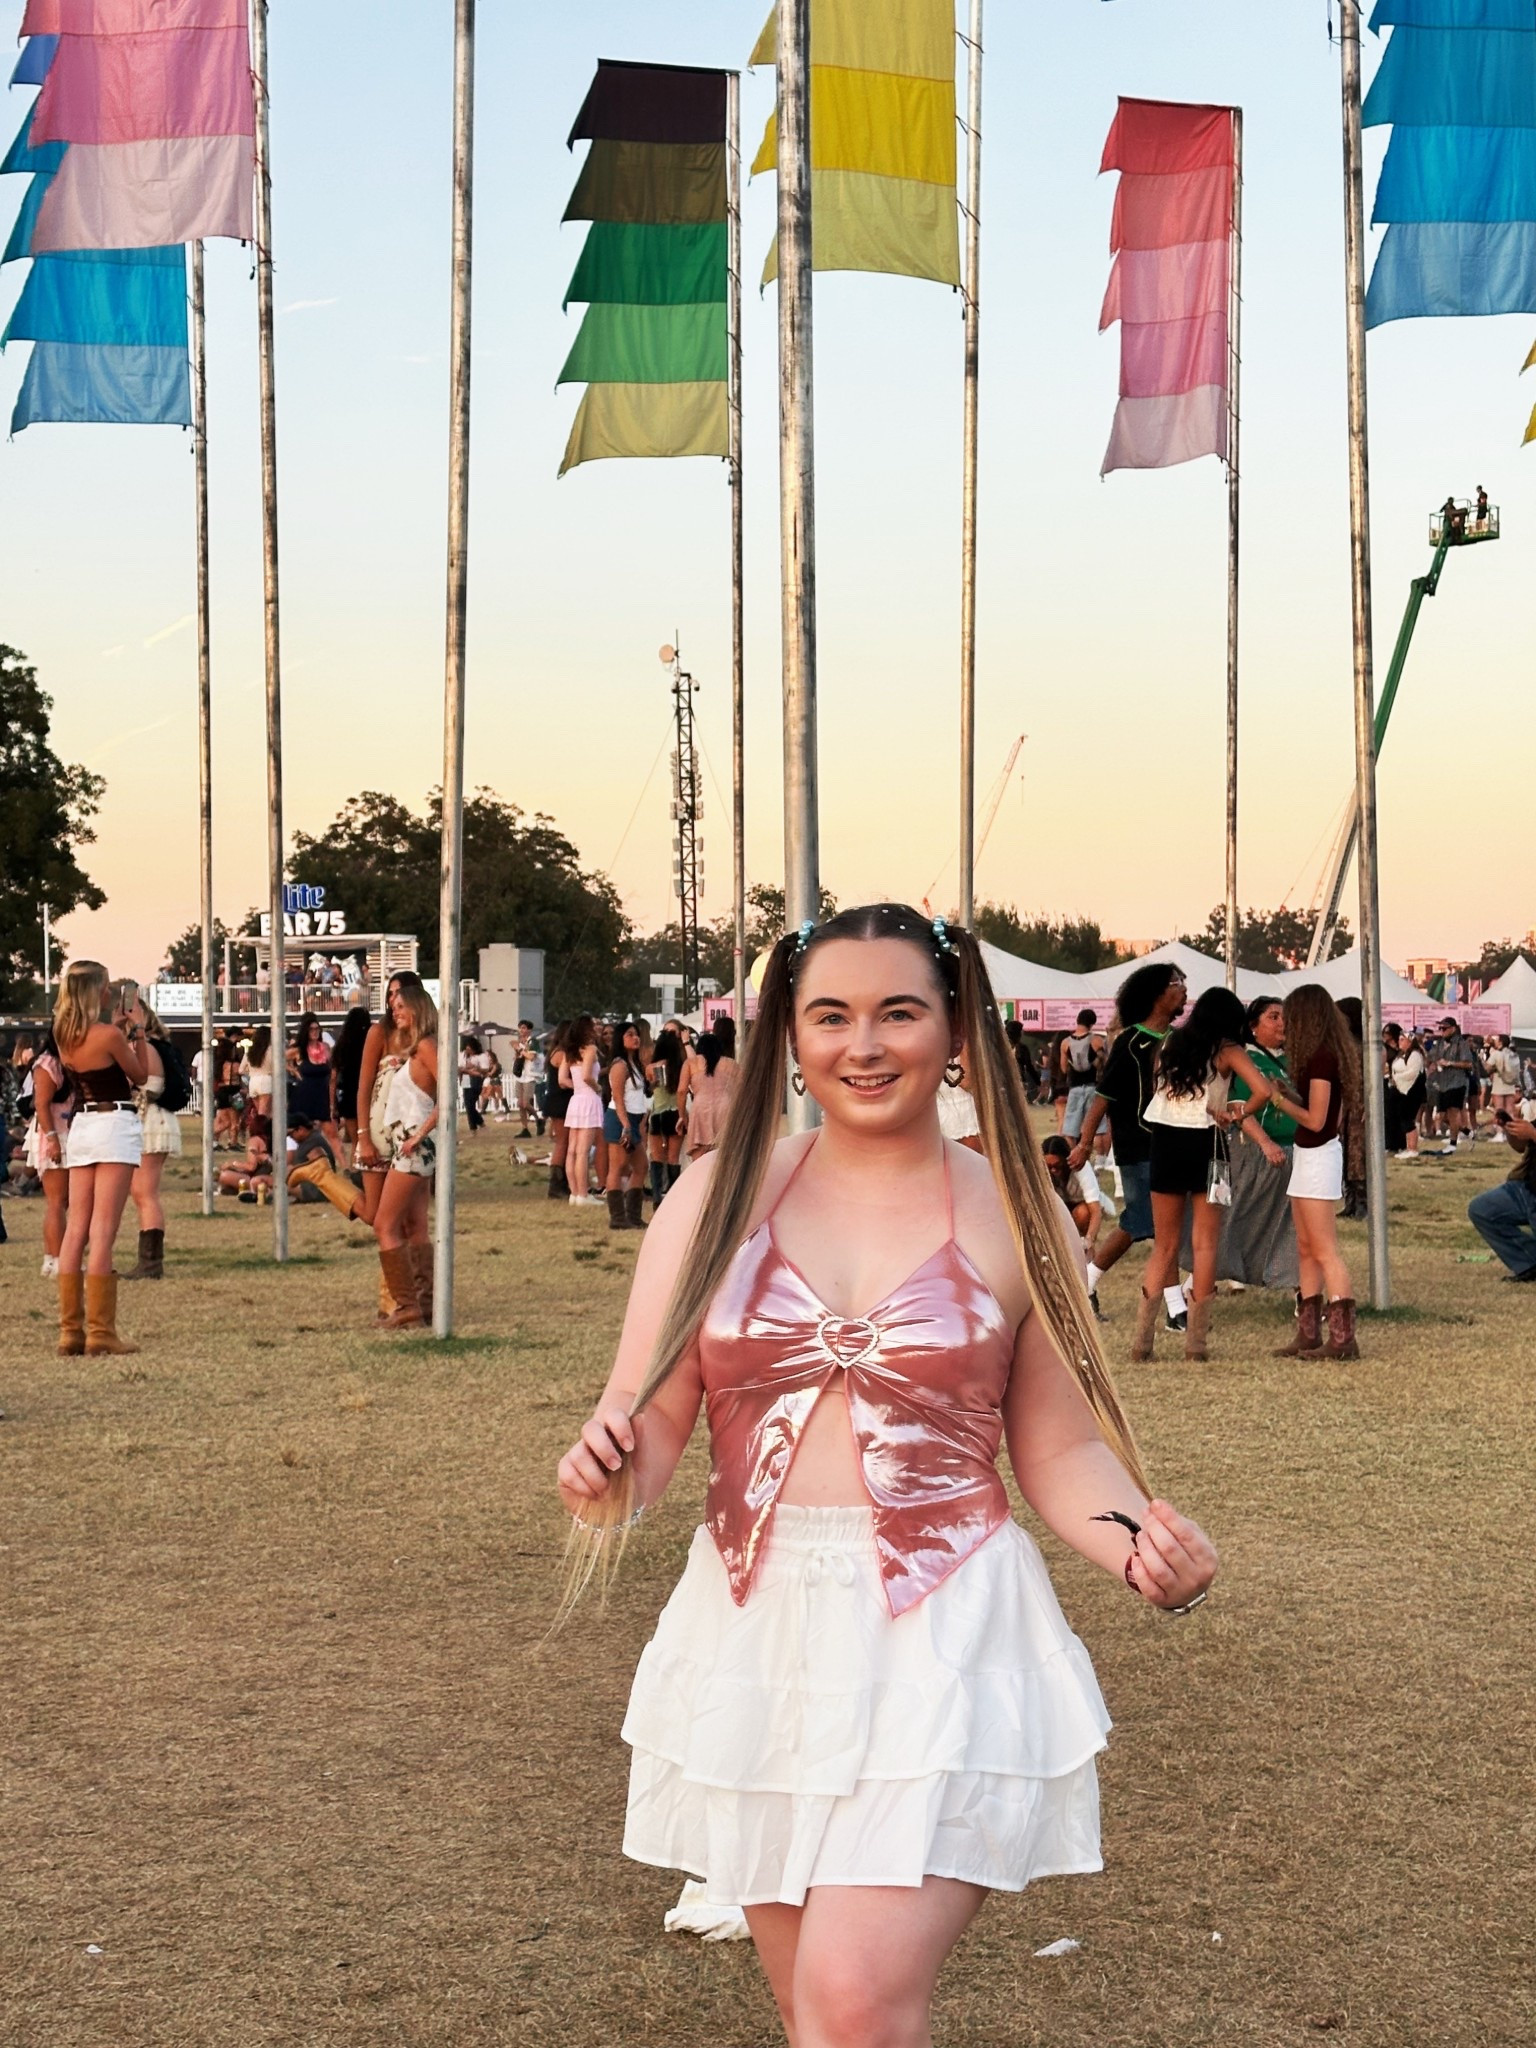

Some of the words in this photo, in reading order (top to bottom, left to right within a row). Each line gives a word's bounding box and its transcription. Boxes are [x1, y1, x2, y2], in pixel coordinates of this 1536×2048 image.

[283, 883, 325, 915] Lite
[313, 910, 346, 936] 75
[1022, 1009, 1039, 1021] BAR
